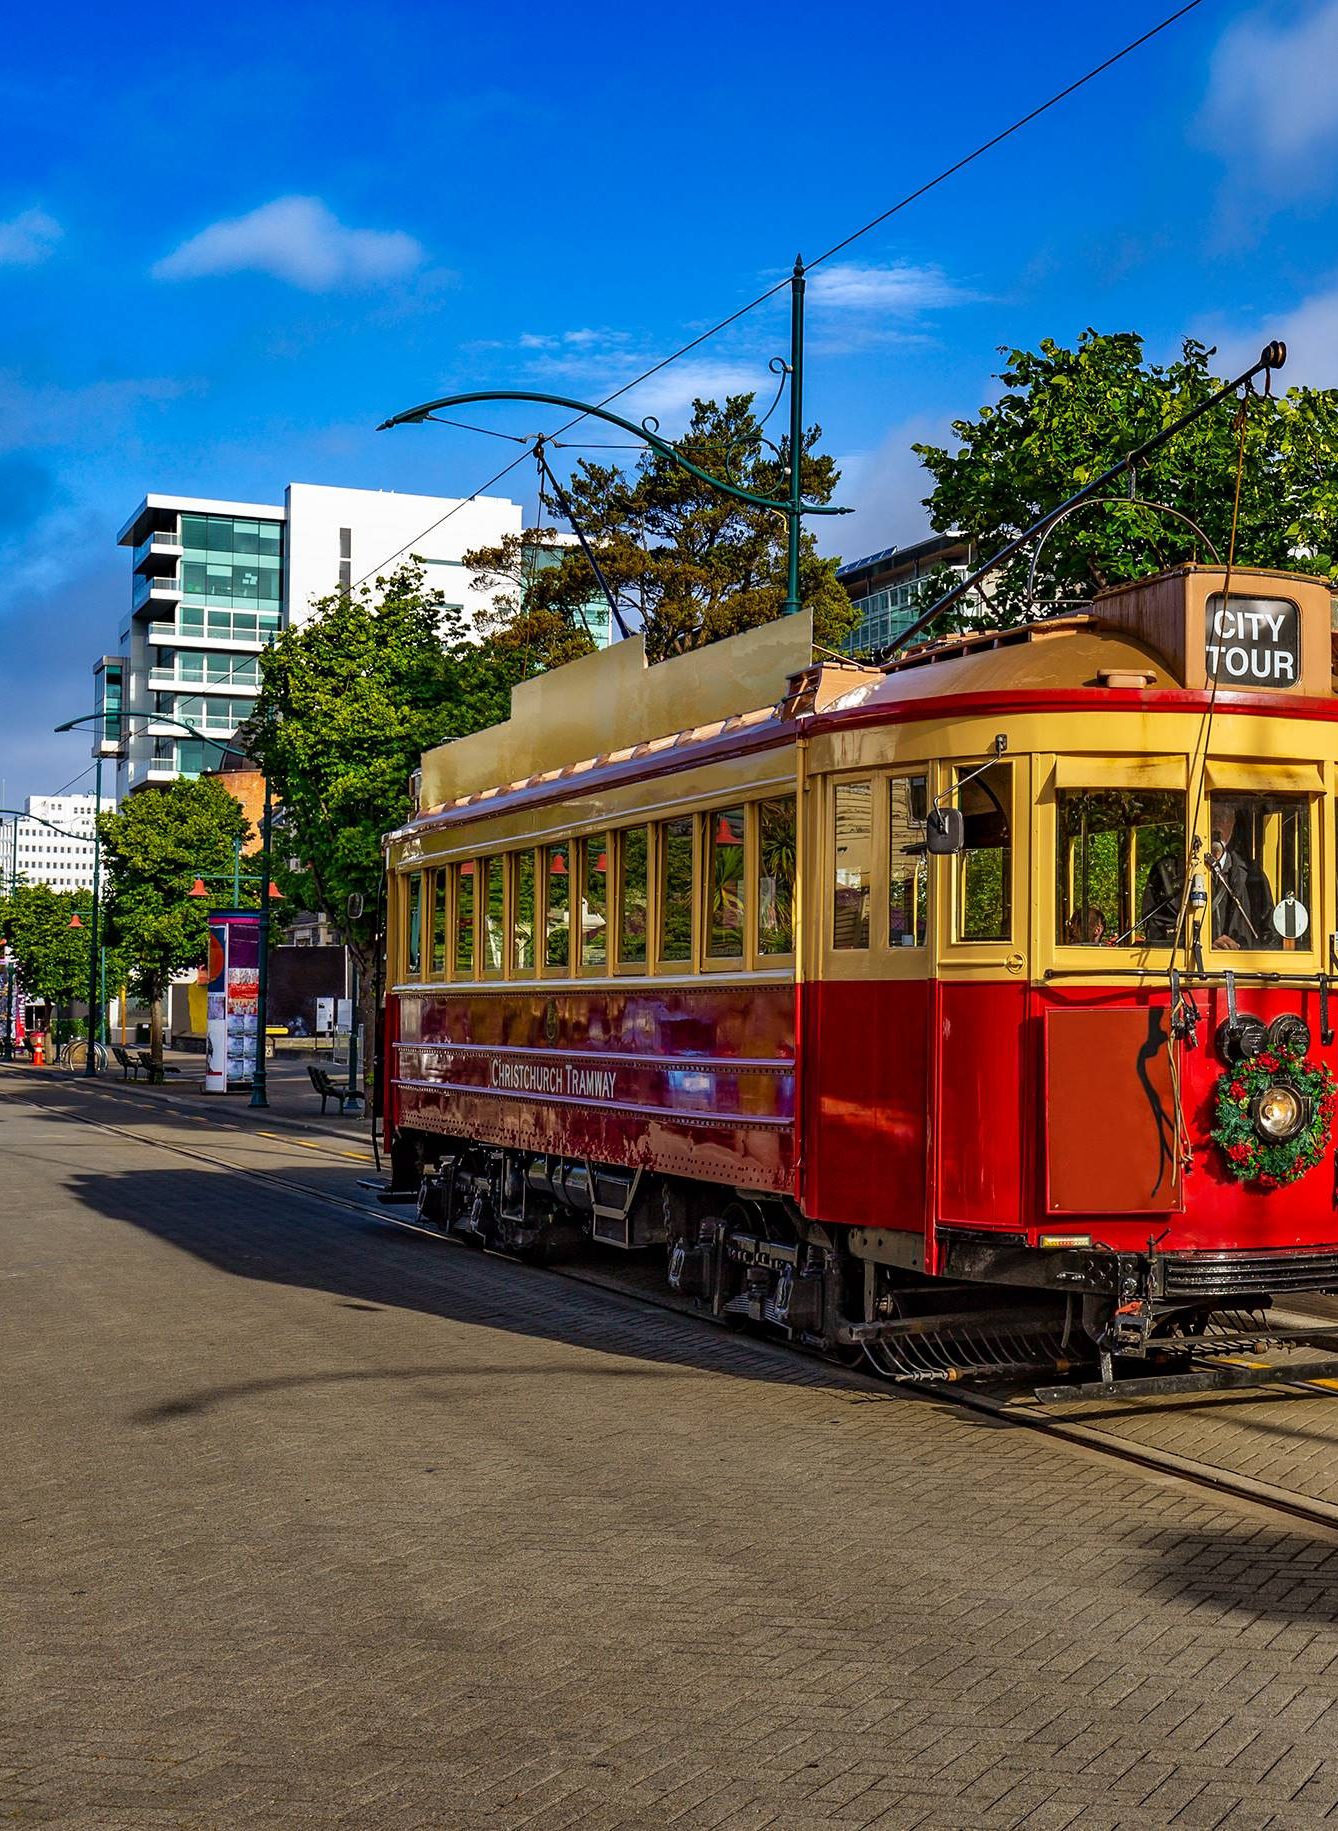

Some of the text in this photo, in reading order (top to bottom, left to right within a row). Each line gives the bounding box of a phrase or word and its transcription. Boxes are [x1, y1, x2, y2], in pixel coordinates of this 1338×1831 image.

[1214, 609, 1285, 642] CITY
[1206, 645, 1294, 680] TOUR
[491, 1058, 617, 1098] CHRISTCHURCH TRAMWAY
